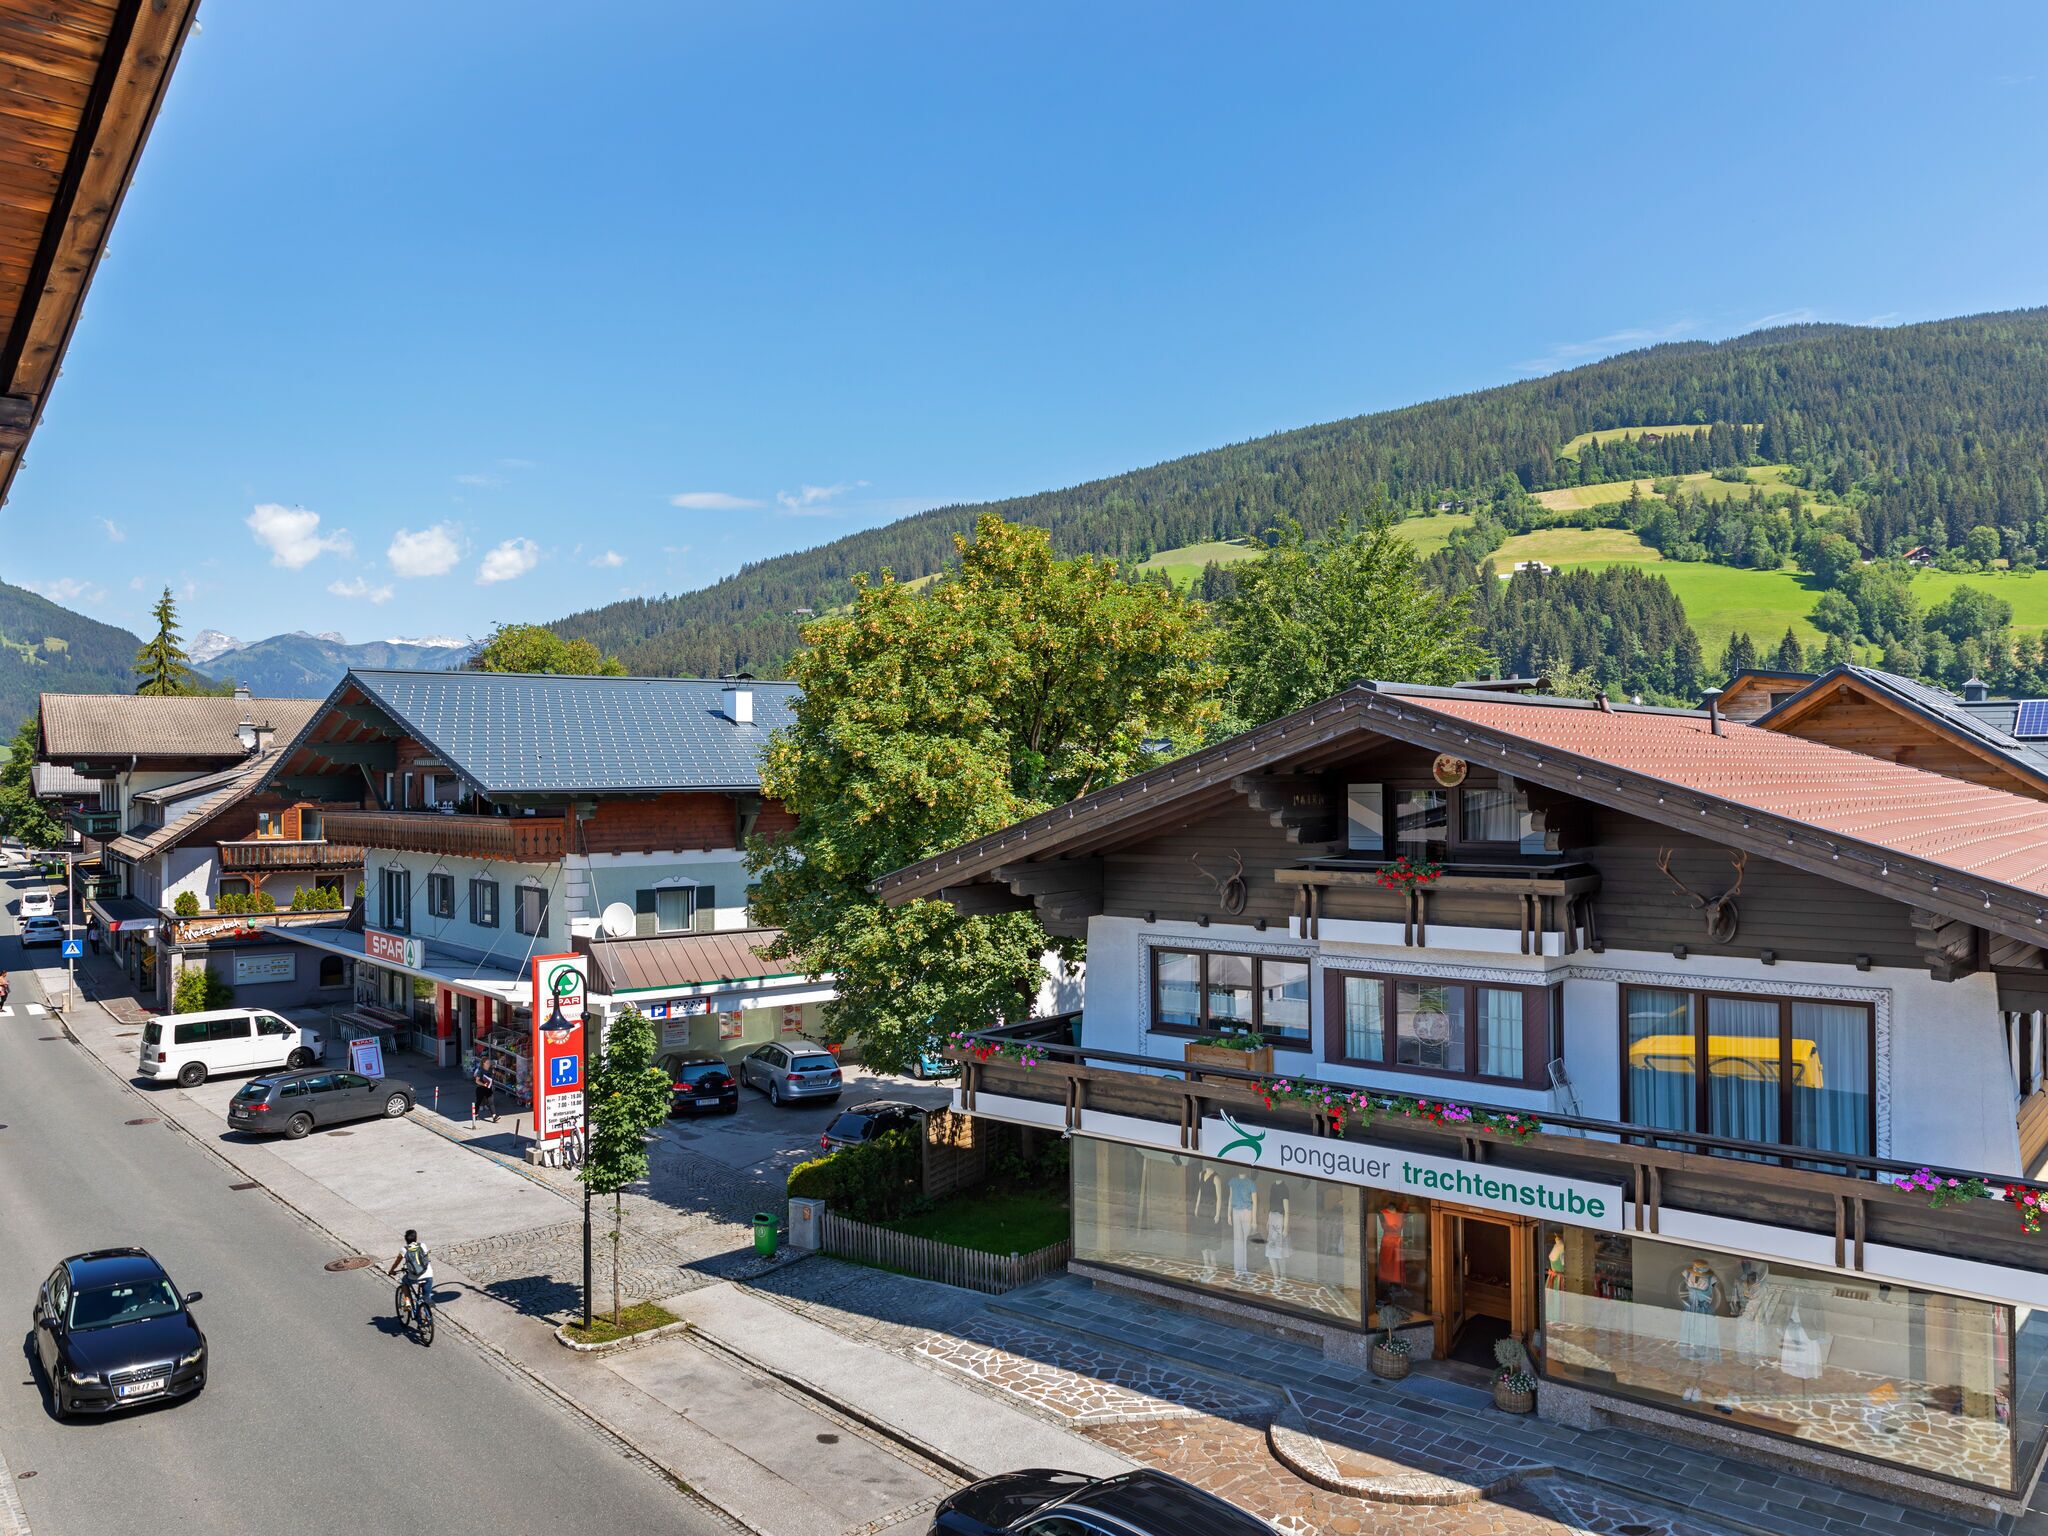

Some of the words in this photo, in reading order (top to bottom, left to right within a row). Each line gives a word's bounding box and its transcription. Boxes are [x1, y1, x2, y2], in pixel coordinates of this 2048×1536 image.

[372, 935, 404, 960] SPAR
[655, 1005, 664, 1017] P
[559, 1059, 572, 1076] P
[1280, 1141, 1391, 1179] pongauer
[1403, 1161, 1605, 1218] trachtenstube
